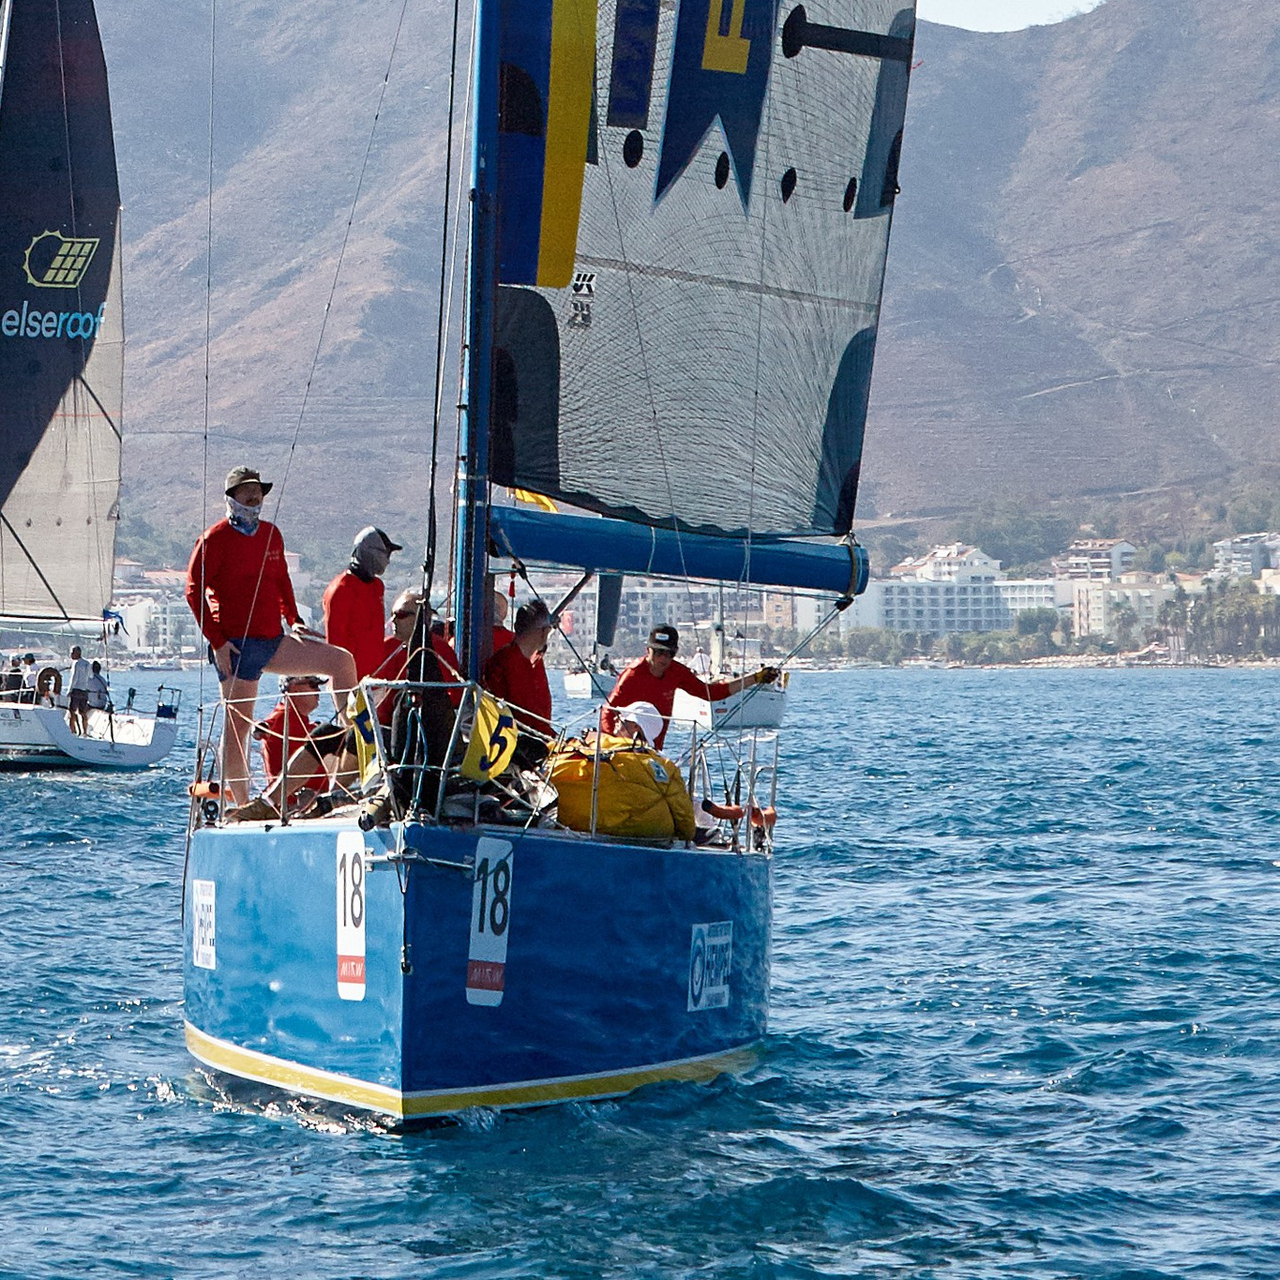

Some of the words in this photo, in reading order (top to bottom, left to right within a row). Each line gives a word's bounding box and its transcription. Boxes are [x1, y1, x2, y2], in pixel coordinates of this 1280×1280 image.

[1, 300, 107, 339] elseroof
[479, 715, 512, 771] 5
[339, 852, 363, 928] 18
[477, 858, 510, 936] 18
